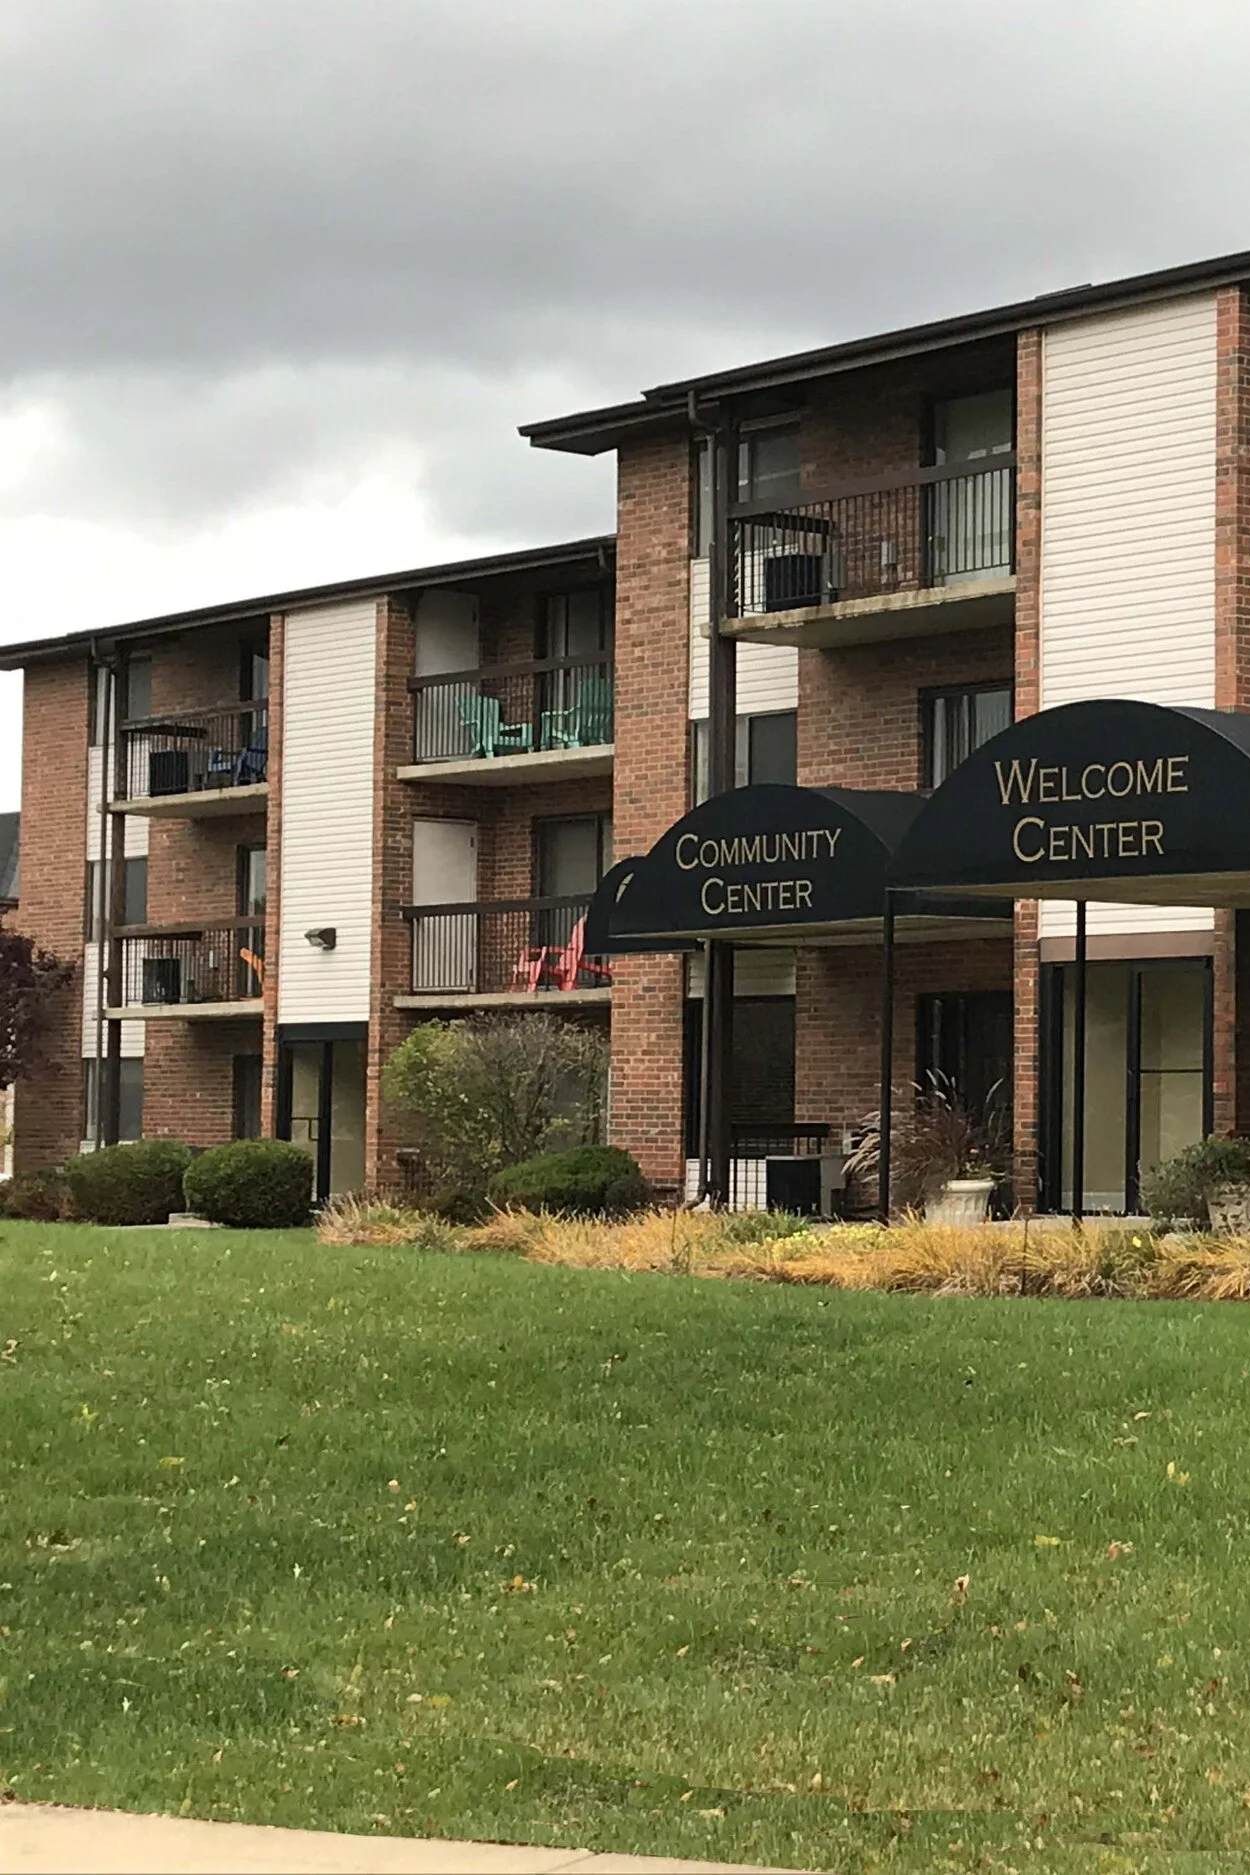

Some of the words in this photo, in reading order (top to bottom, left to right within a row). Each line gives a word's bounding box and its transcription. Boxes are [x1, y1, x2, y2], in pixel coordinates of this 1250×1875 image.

[994, 755, 1189, 805] WELCOME
[675, 828, 842, 870] COMMUNITY
[1013, 816, 1164, 862] CENTER
[701, 877, 813, 915] CENTER
